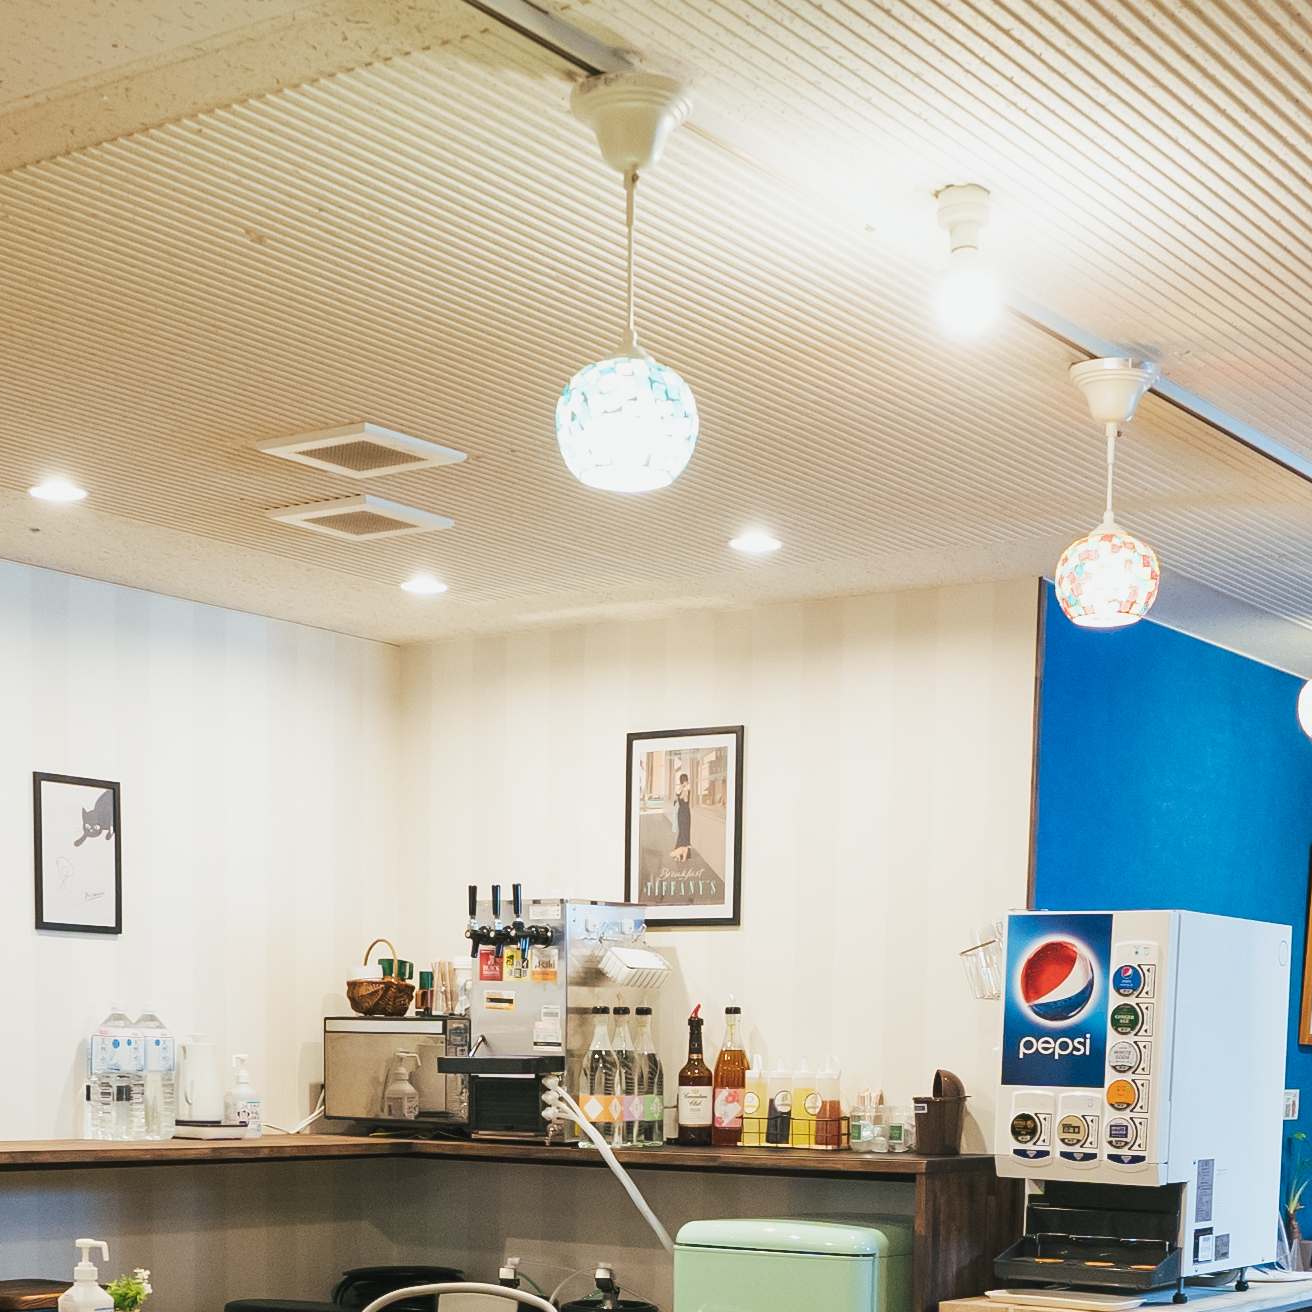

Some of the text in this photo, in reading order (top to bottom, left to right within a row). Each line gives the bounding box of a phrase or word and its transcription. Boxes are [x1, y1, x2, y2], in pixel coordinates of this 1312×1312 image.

[658, 867, 705, 881] Breakfast
[646, 880, 716, 896] TIFFANY'S
[1018, 1033, 1091, 1060] pepsi
